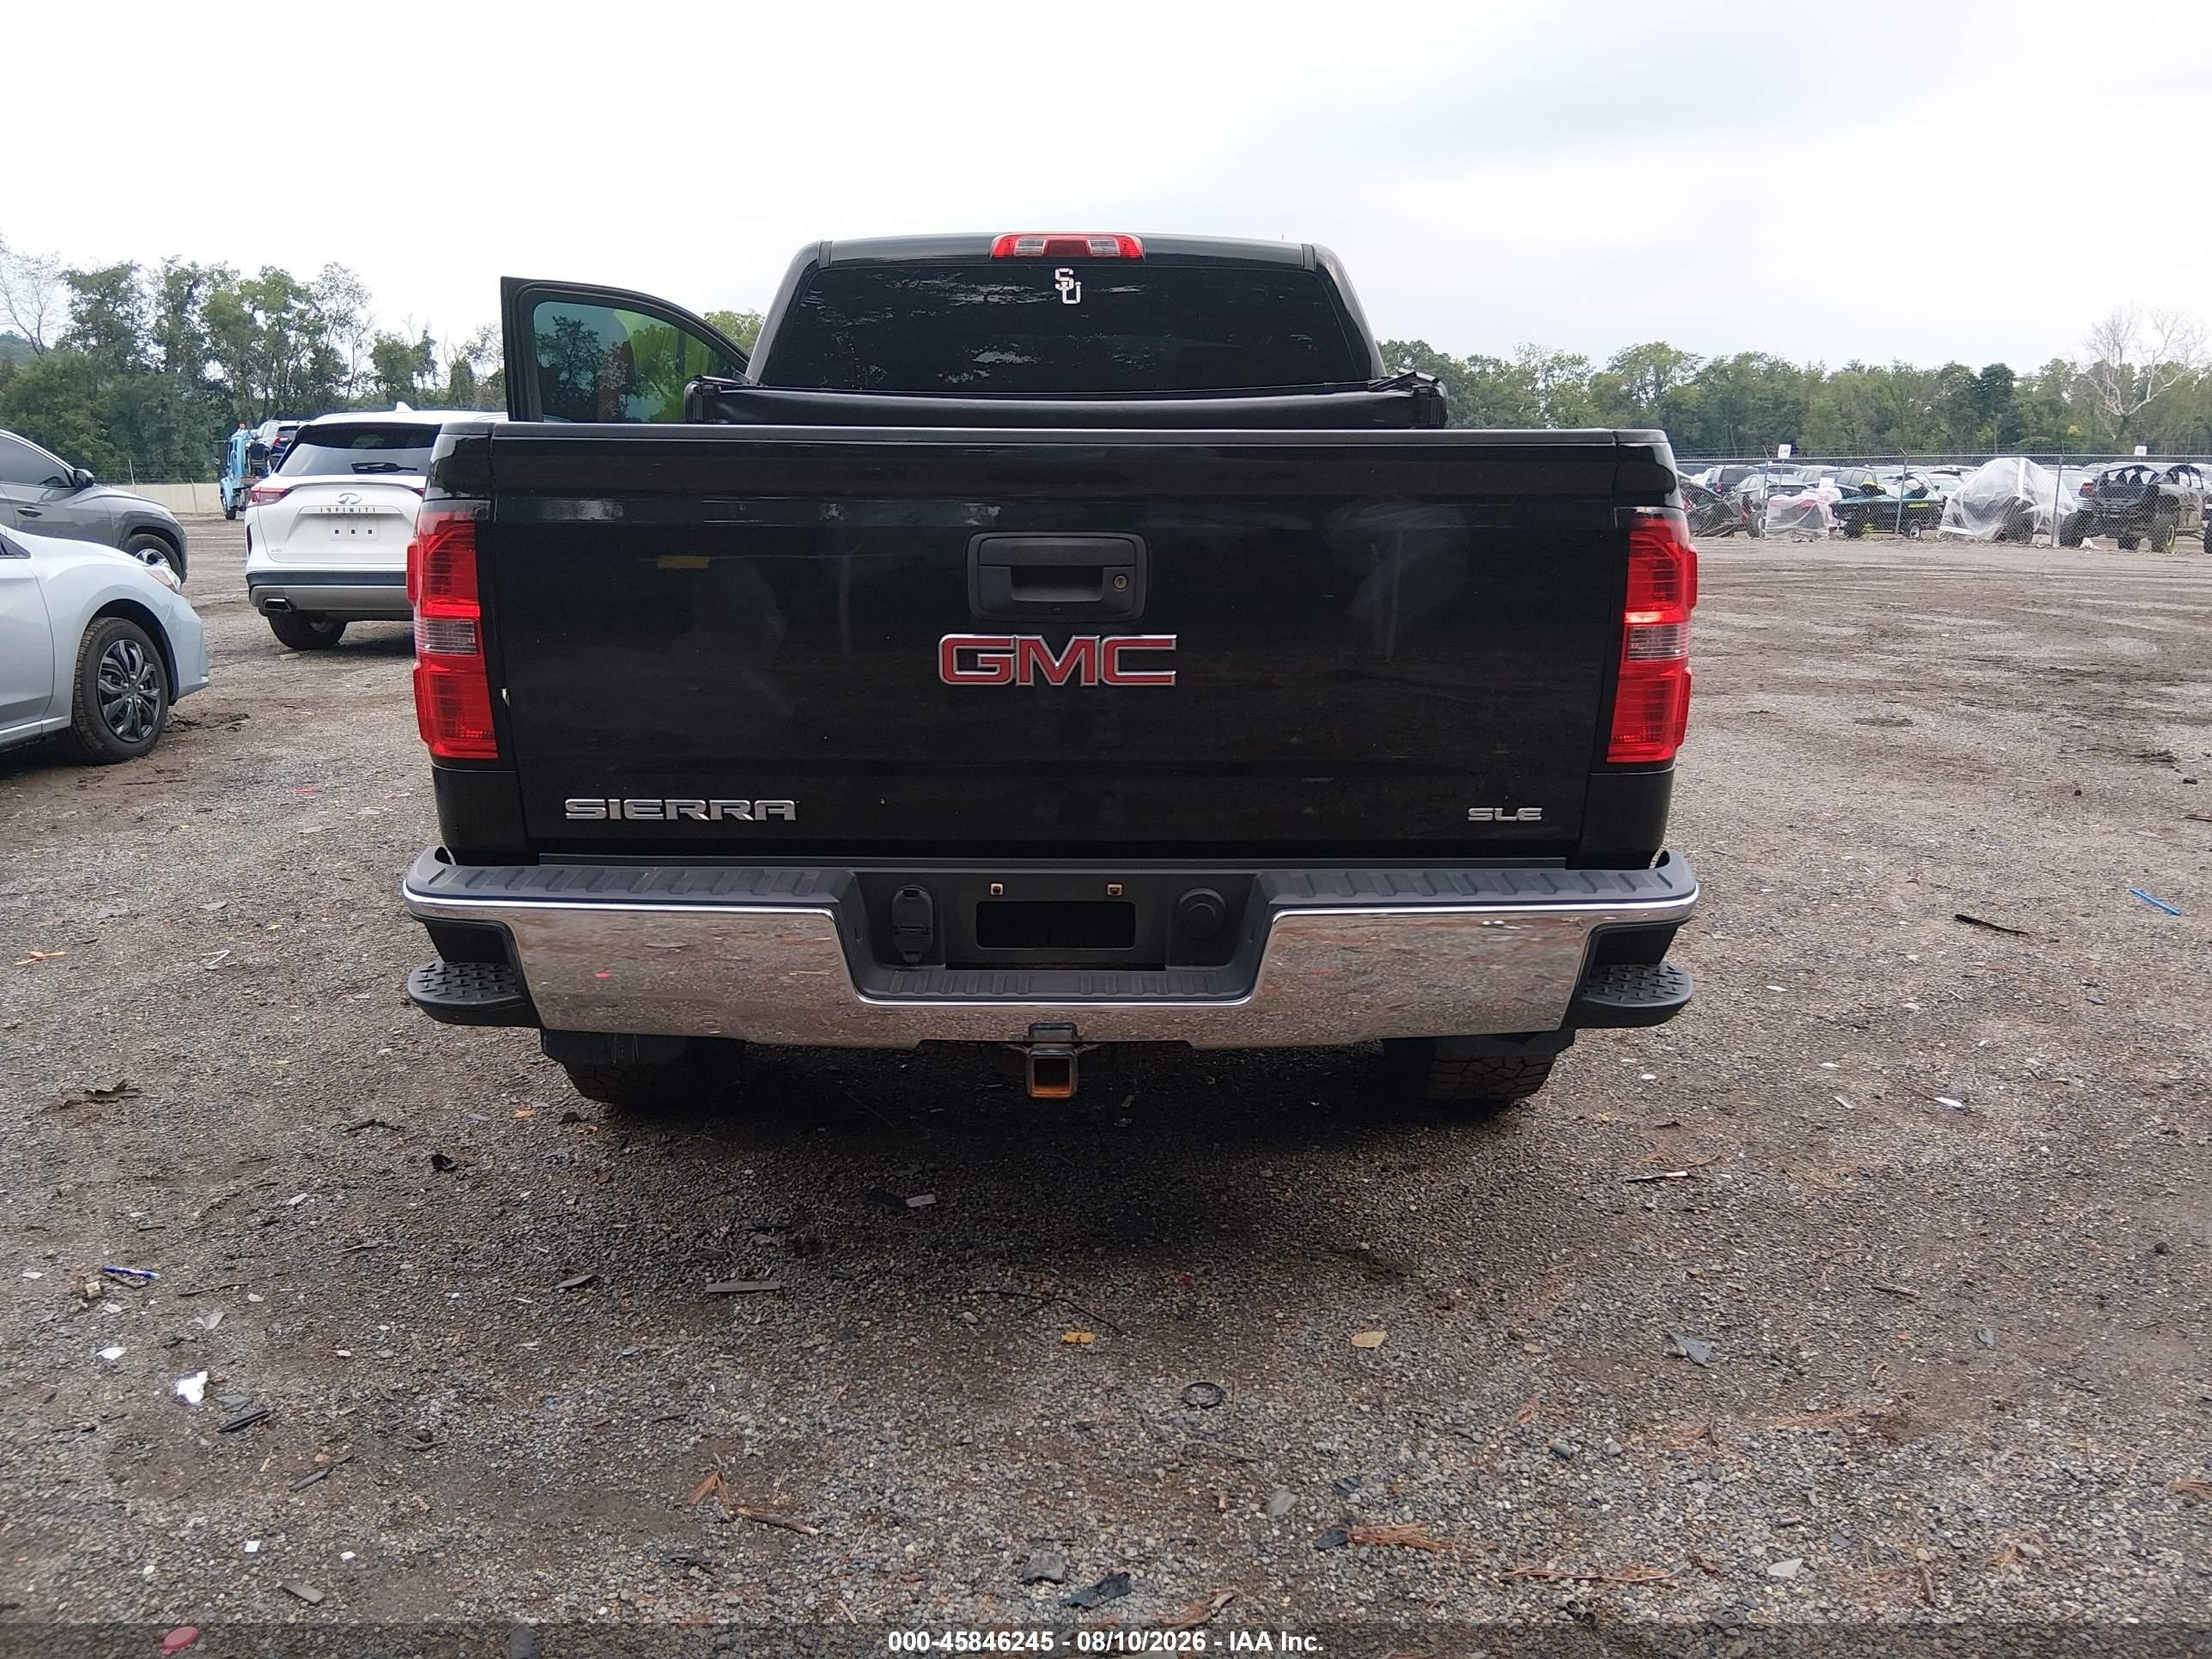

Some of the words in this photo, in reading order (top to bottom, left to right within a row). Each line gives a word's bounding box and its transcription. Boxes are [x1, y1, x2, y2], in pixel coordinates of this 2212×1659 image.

[939, 634, 1177, 686] GMC
[565, 799, 797, 821] SIERRA
[1468, 807, 1543, 821] SLE
